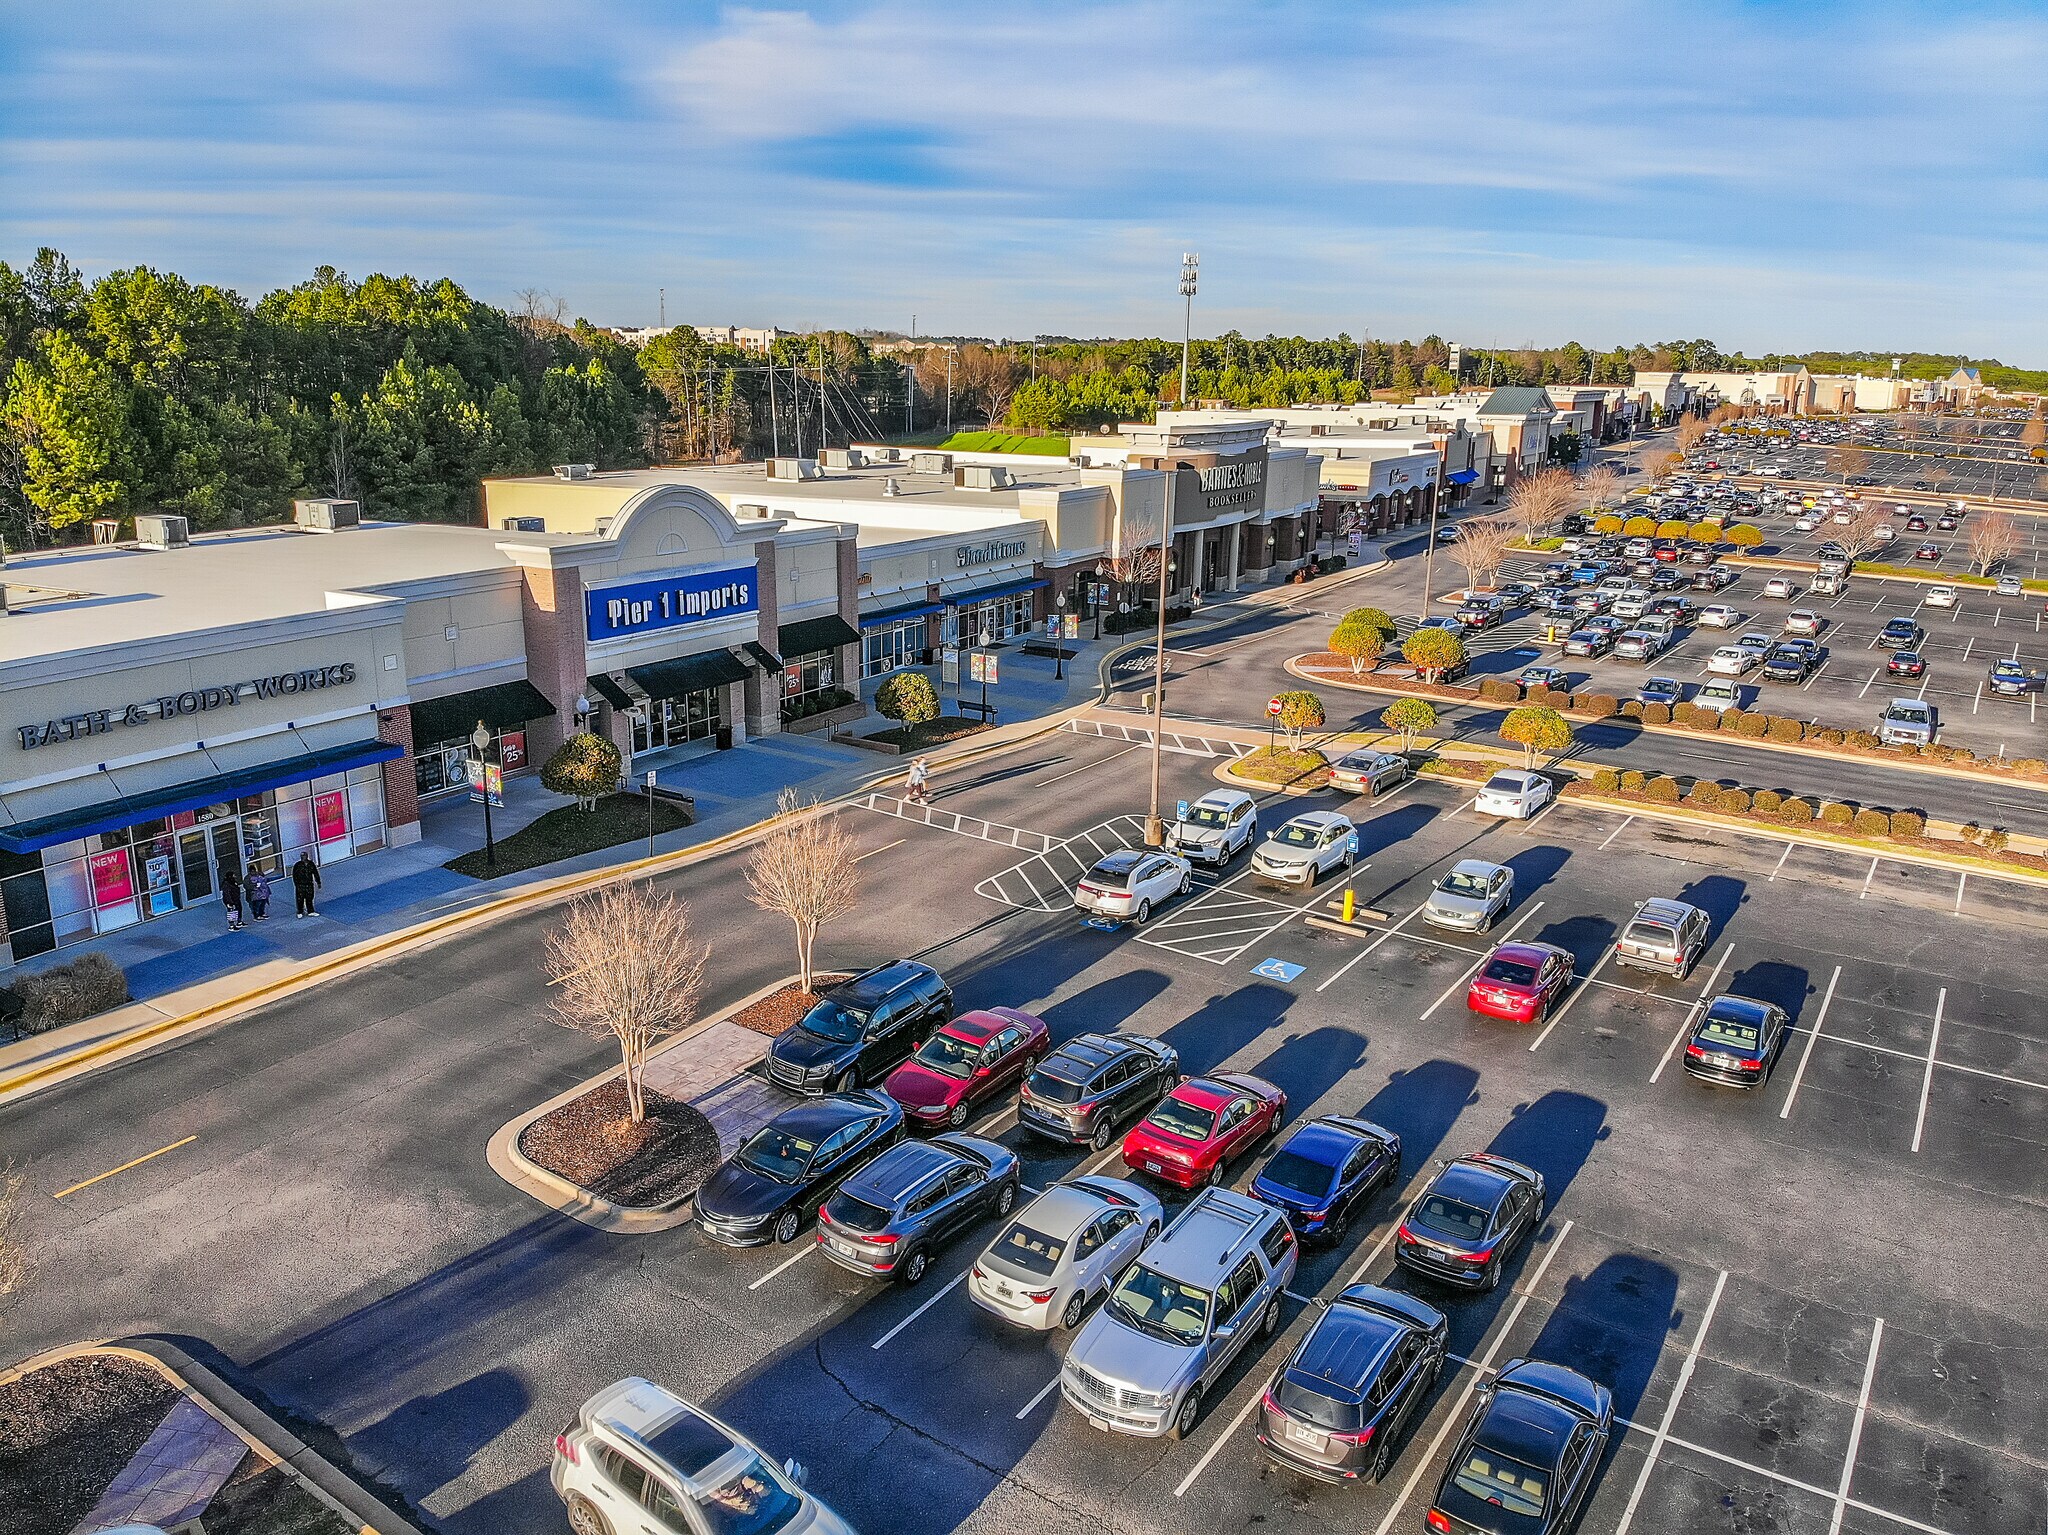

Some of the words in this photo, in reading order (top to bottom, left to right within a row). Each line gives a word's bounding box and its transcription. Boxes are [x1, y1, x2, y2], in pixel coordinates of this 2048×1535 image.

[1200, 465, 1237, 492] BARNES
[1237, 463, 1245, 488] &
[1244, 460, 1262, 486] NOBLE
[1208, 490, 1257, 508] BOOKSELLERS
[956, 540, 1026, 568] Traditions
[607, 598, 653, 628] Pier
[660, 591, 670, 618] 1
[18, 709, 113, 750] BATH
[123, 704, 150, 727] &
[157, 682, 243, 720] BODY
[253, 662, 357, 700] WORKS
[315, 795, 335, 807] NEW
[197, 813, 214, 823] 1580
[92, 853, 118, 870] NEW
